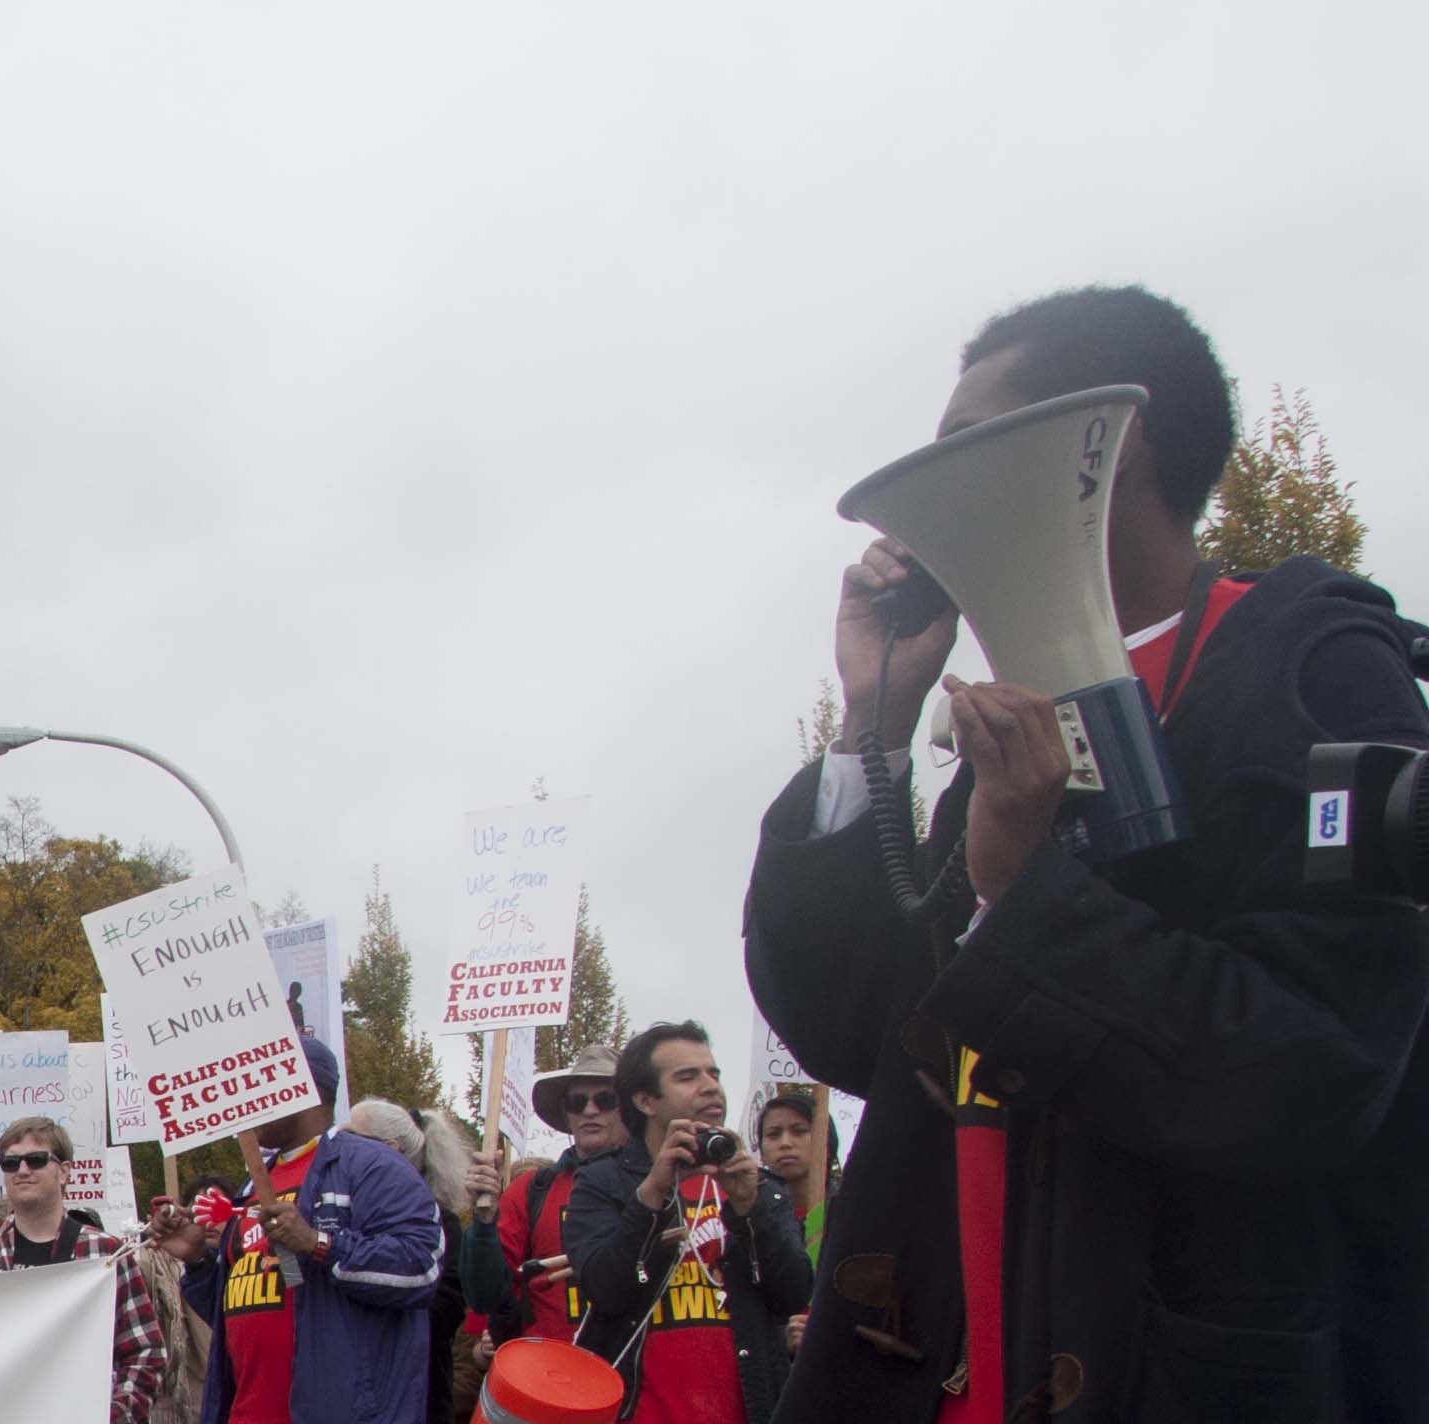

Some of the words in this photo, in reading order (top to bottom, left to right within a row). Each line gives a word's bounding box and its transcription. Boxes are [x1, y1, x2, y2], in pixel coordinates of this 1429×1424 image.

[1078, 417, 1106, 502] CFA
[1320, 798, 1338, 839] CTA
[131, 915, 250, 977] ENOUGH
[451, 958, 566, 981] CALIFORNIA
[147, 981, 270, 1046] ENOUGH
[443, 1001, 563, 1024] ASSOCIATION
[448, 977, 563, 1002] FACULTY
[0, 1049, 16, 1068] is
[22, 1048, 69, 1068] about
[147, 1037, 295, 1096] CALIFORNIA
[154, 1057, 298, 1120] FACULTY
[163, 1081, 309, 1143] ASSOCIATION
[229, 1271, 281, 1310] WILL
